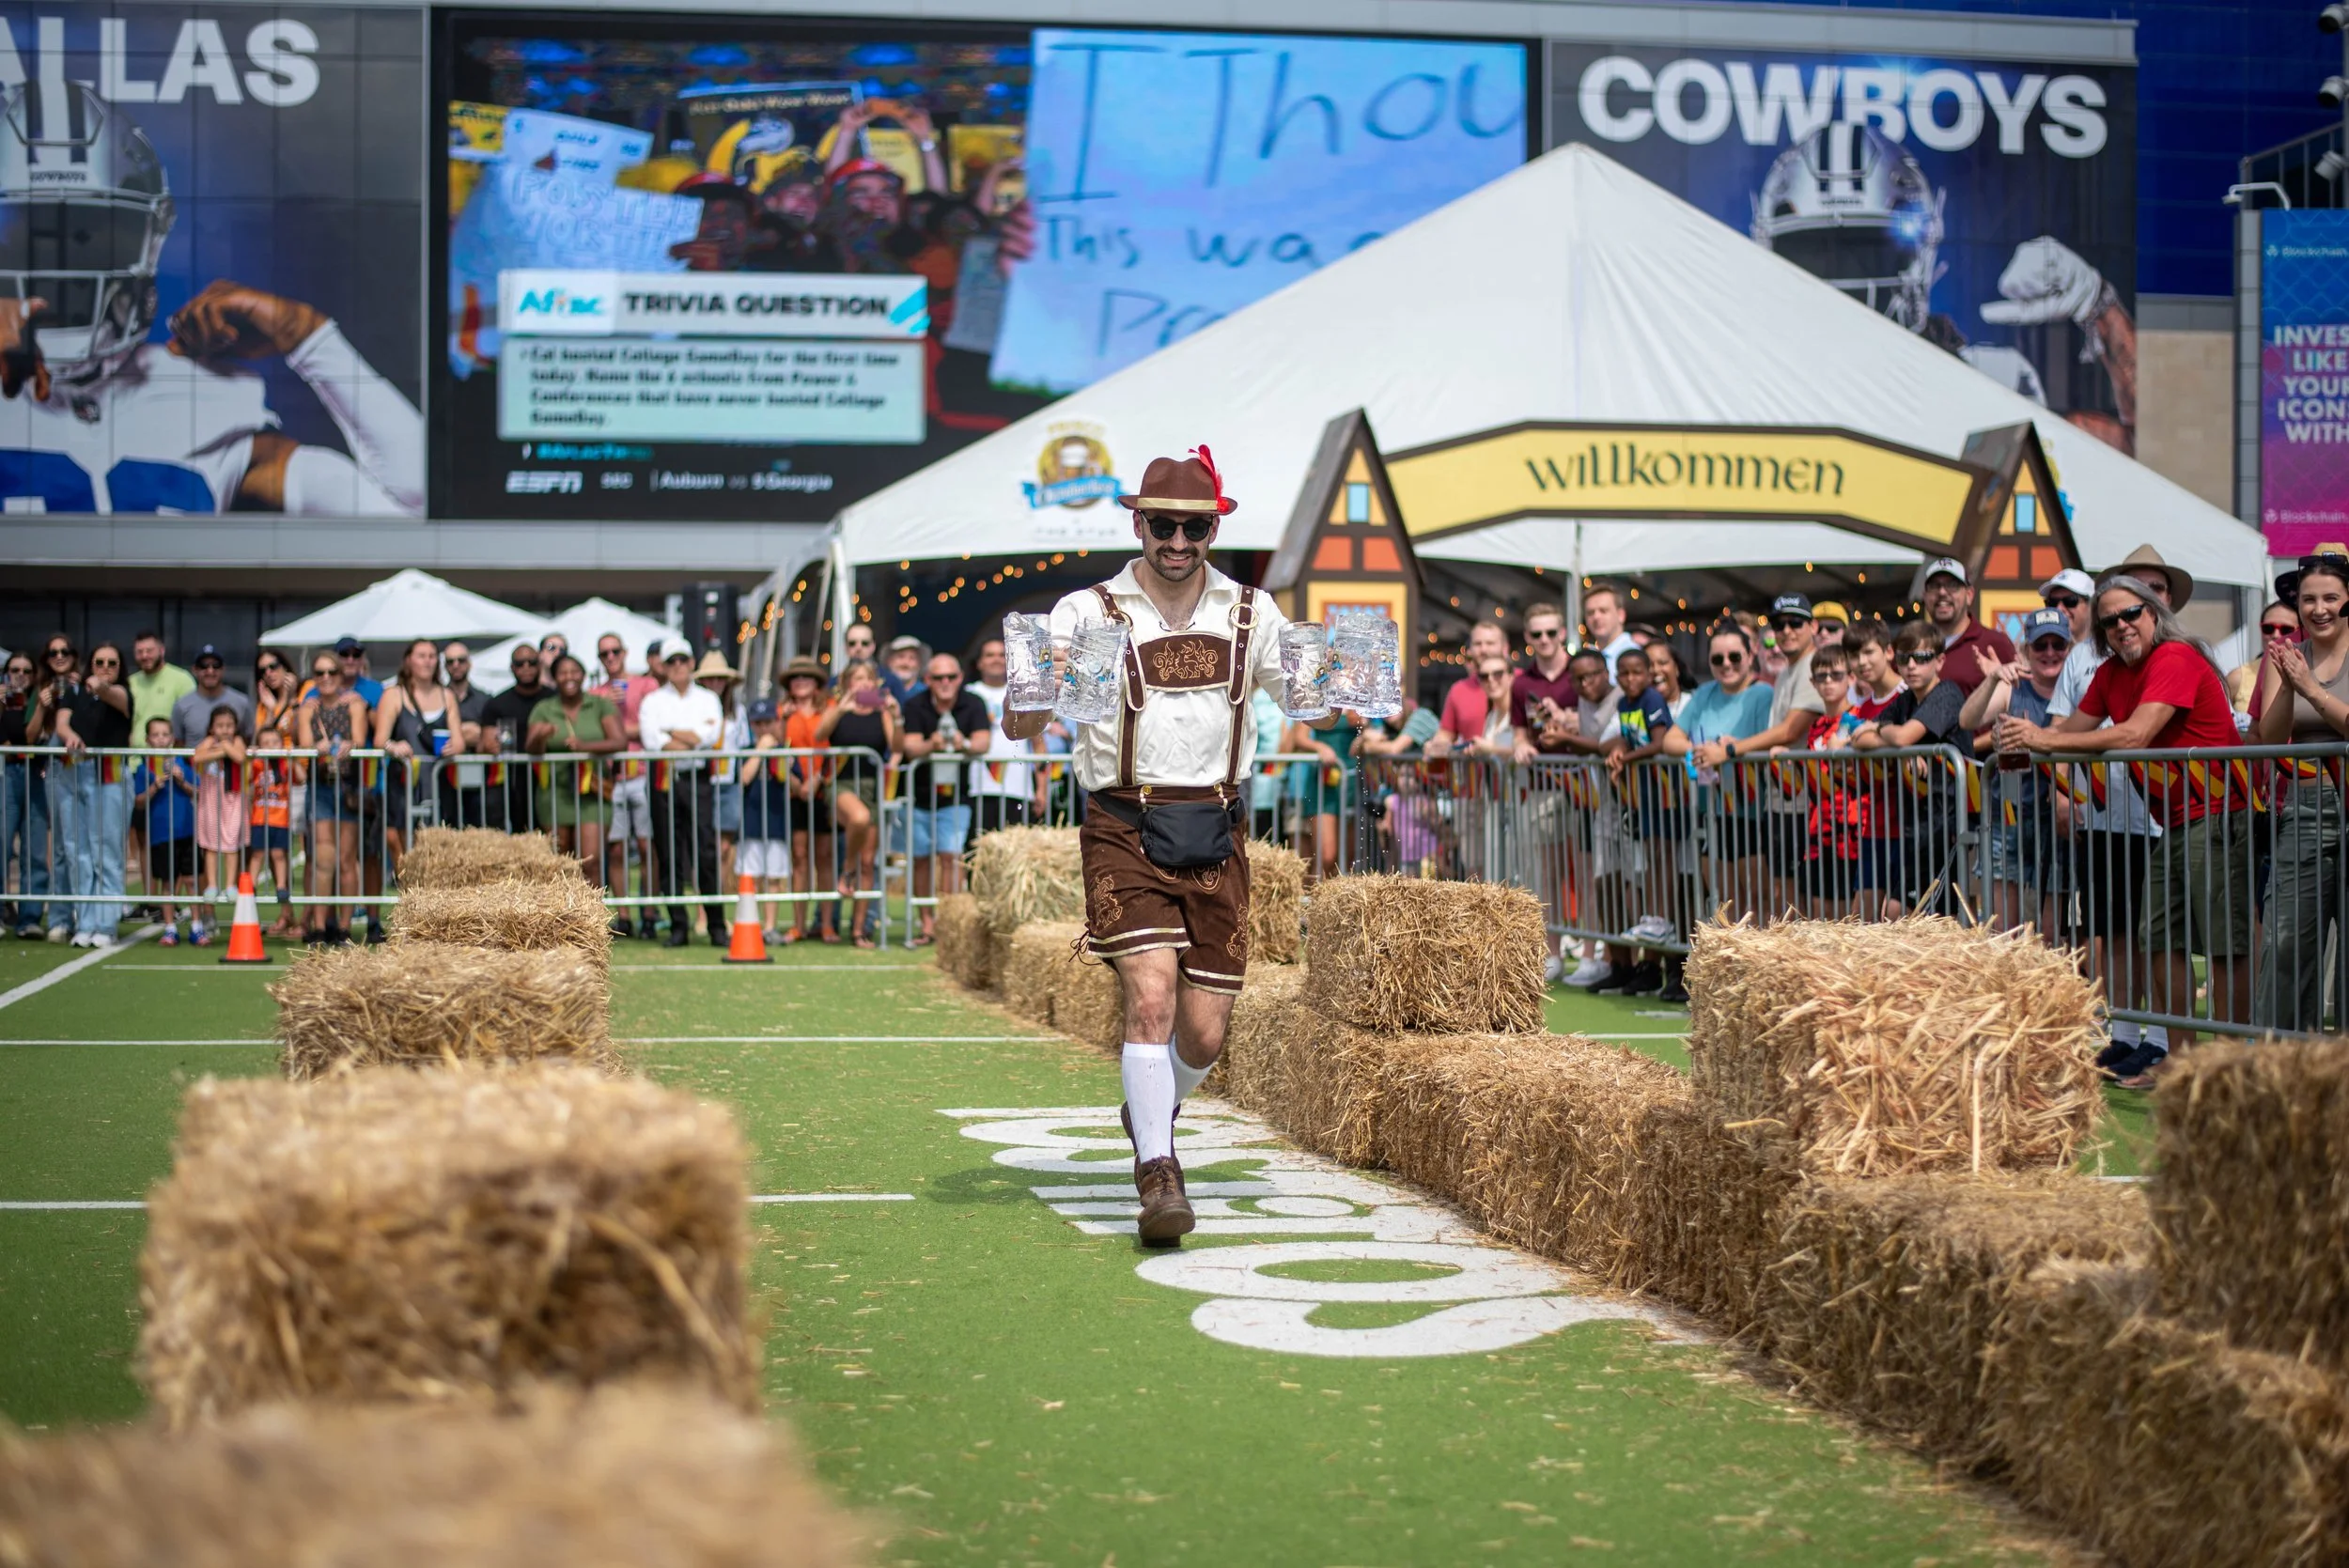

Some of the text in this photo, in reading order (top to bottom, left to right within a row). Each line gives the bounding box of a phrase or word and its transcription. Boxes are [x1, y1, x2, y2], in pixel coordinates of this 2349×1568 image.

[1579, 55, 2108, 158] COWBOYS
[625, 292, 889, 316] TRIVIA QUESTION
[2293, 349, 2348, 372] LIKE
[2278, 398, 2349, 421] ICON
[2284, 421, 2349, 444] WITH
[506, 471, 583, 493] ESPN
[660, 471, 724, 489] Auburn
